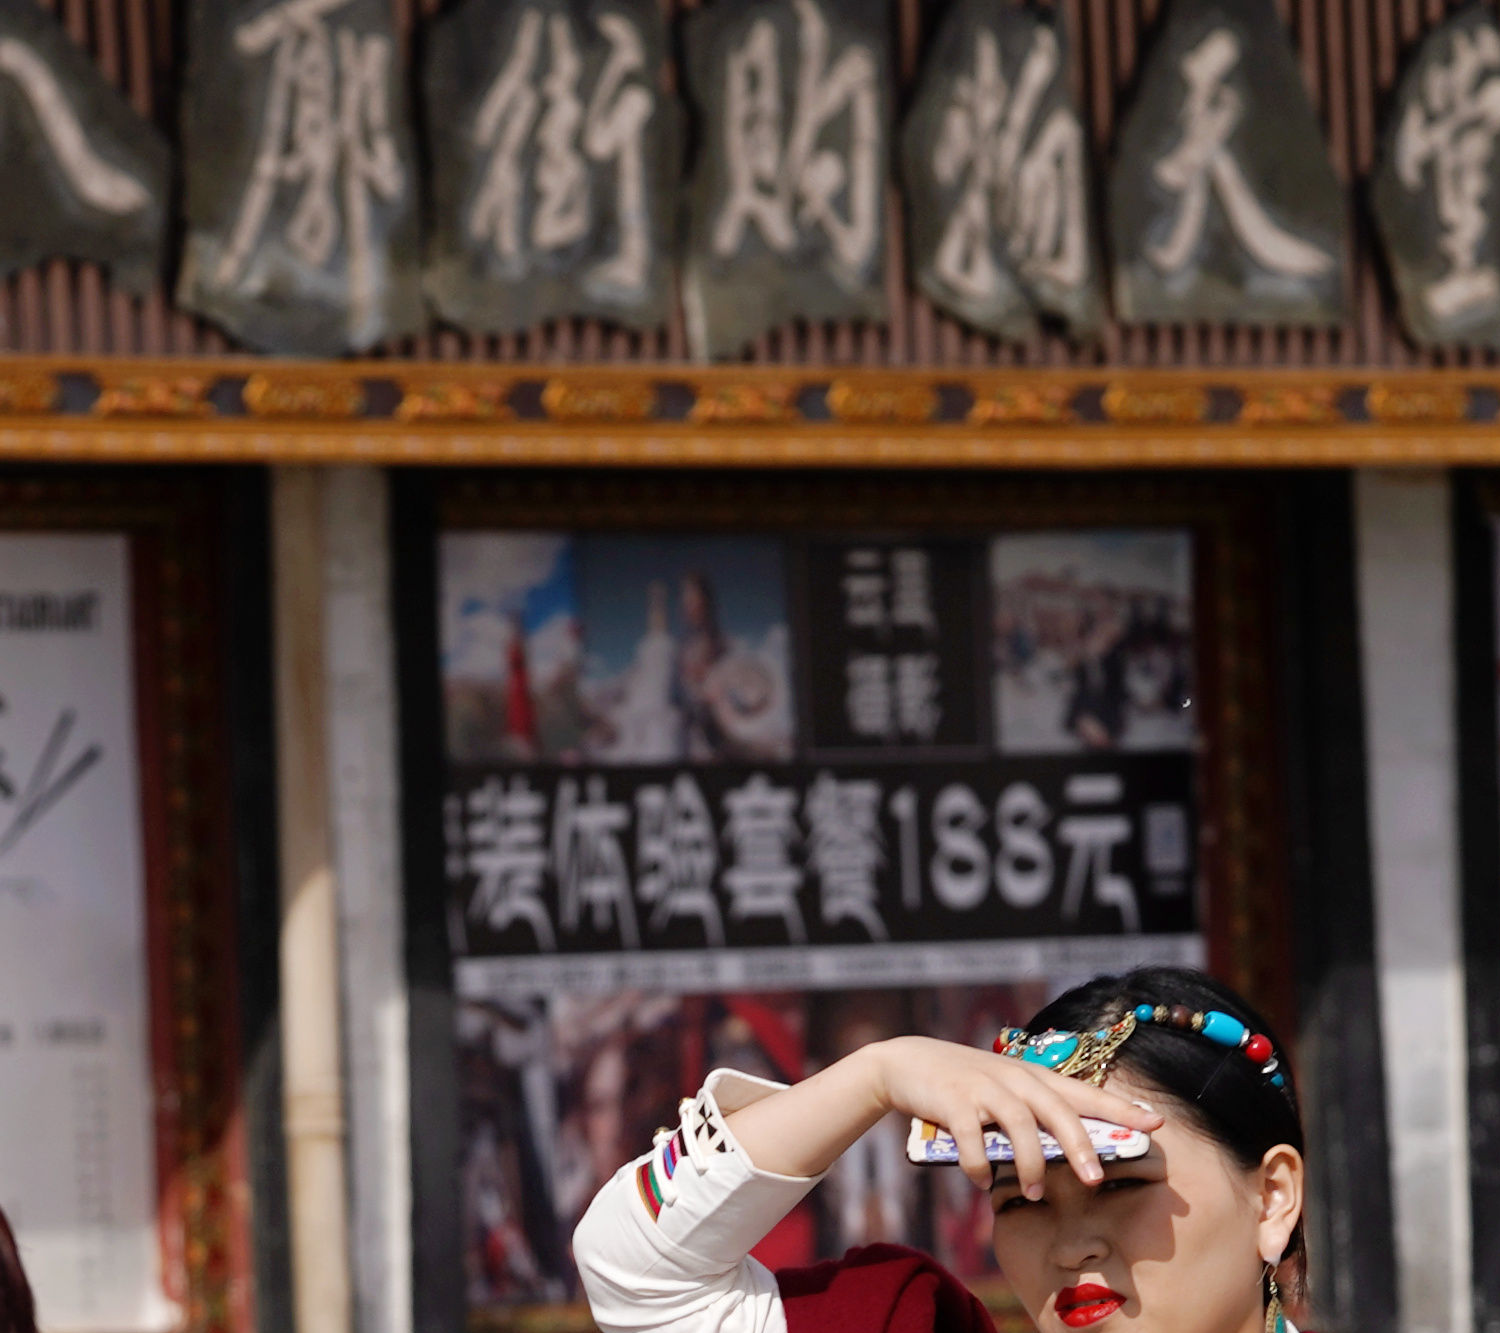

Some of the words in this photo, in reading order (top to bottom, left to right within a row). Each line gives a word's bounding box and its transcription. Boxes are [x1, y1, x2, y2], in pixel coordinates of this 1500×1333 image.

[445, 770, 1143, 955] 装体验套餐188元
